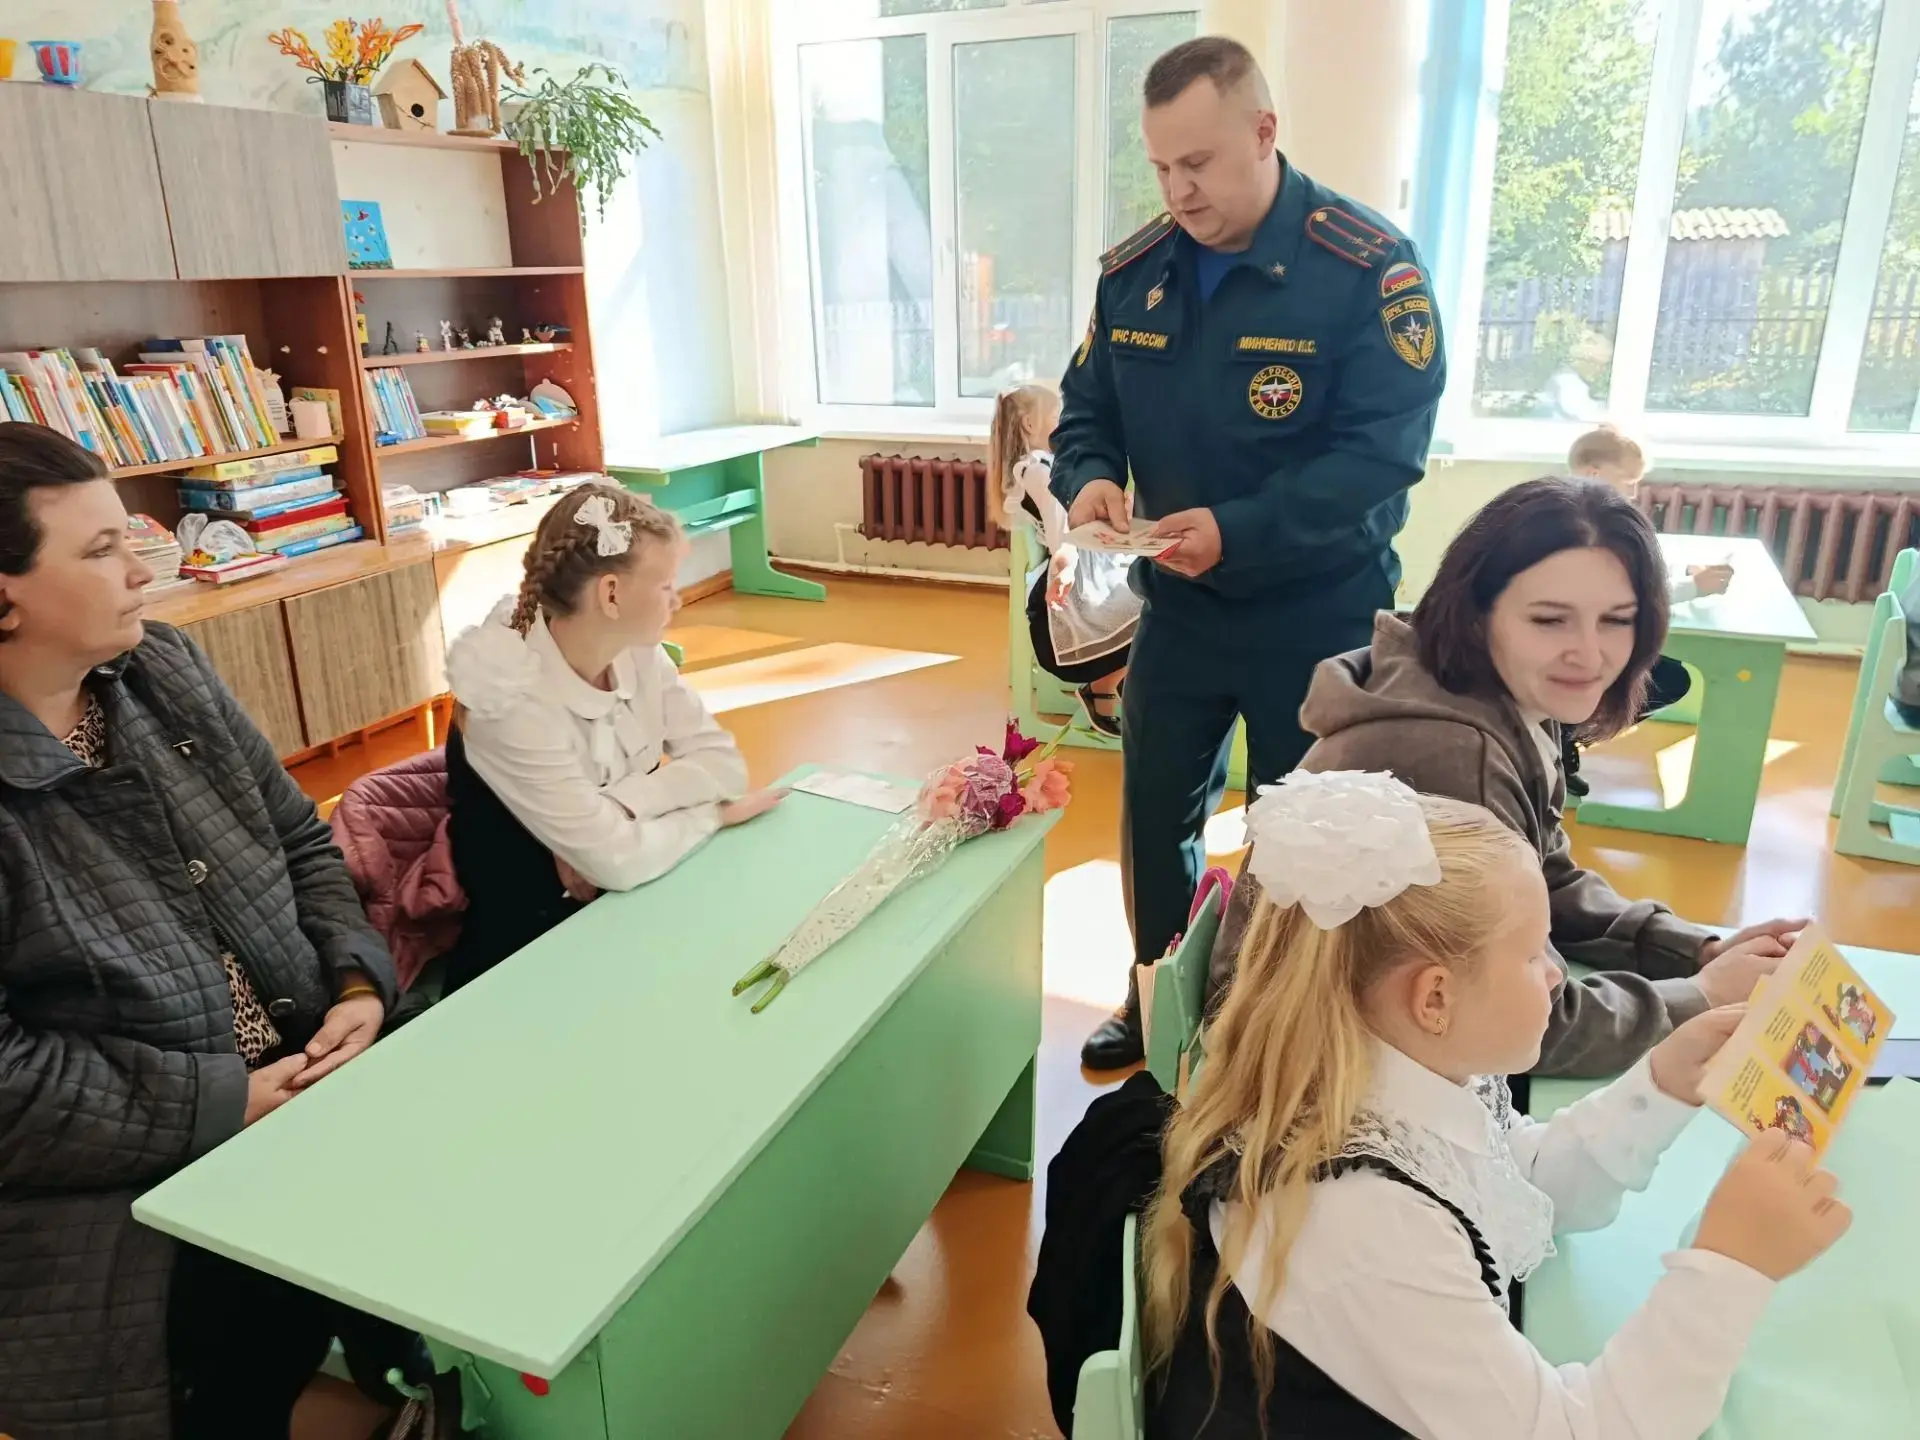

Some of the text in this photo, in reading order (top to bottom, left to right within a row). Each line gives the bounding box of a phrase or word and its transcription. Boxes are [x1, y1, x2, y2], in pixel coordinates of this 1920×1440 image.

[1111, 328, 1169, 348] МЧС РОССИИ
[1251, 367, 1300, 390] МЧС РОССИИ
